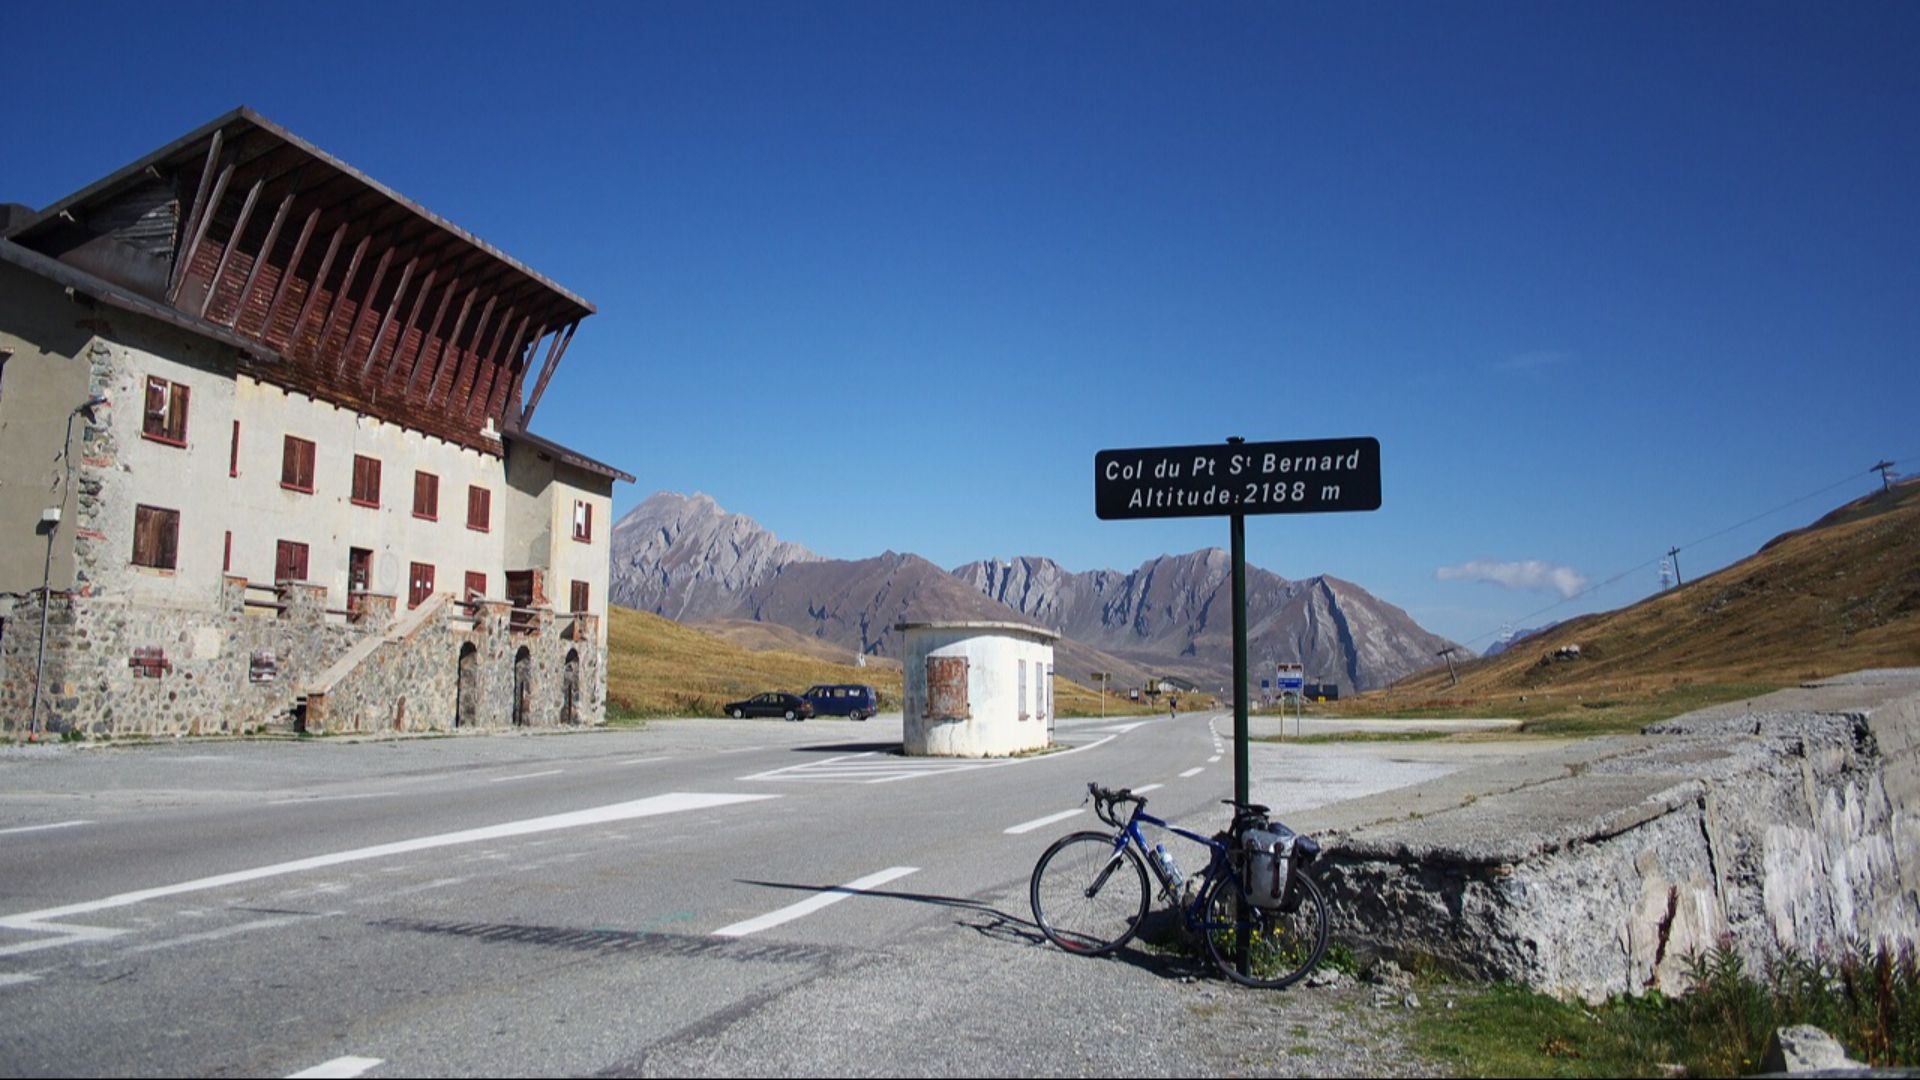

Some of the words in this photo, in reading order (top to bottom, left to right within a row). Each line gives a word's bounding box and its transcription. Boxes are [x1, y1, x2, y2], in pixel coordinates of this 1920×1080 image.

[1105, 459, 1143, 481] Col
[1154, 458, 1180, 479] du
[1192, 456, 1216, 477] Pt
[1229, 454, 1252, 475] St
[1262, 449, 1360, 474] Bernard
[1321, 485, 1340, 501] m
